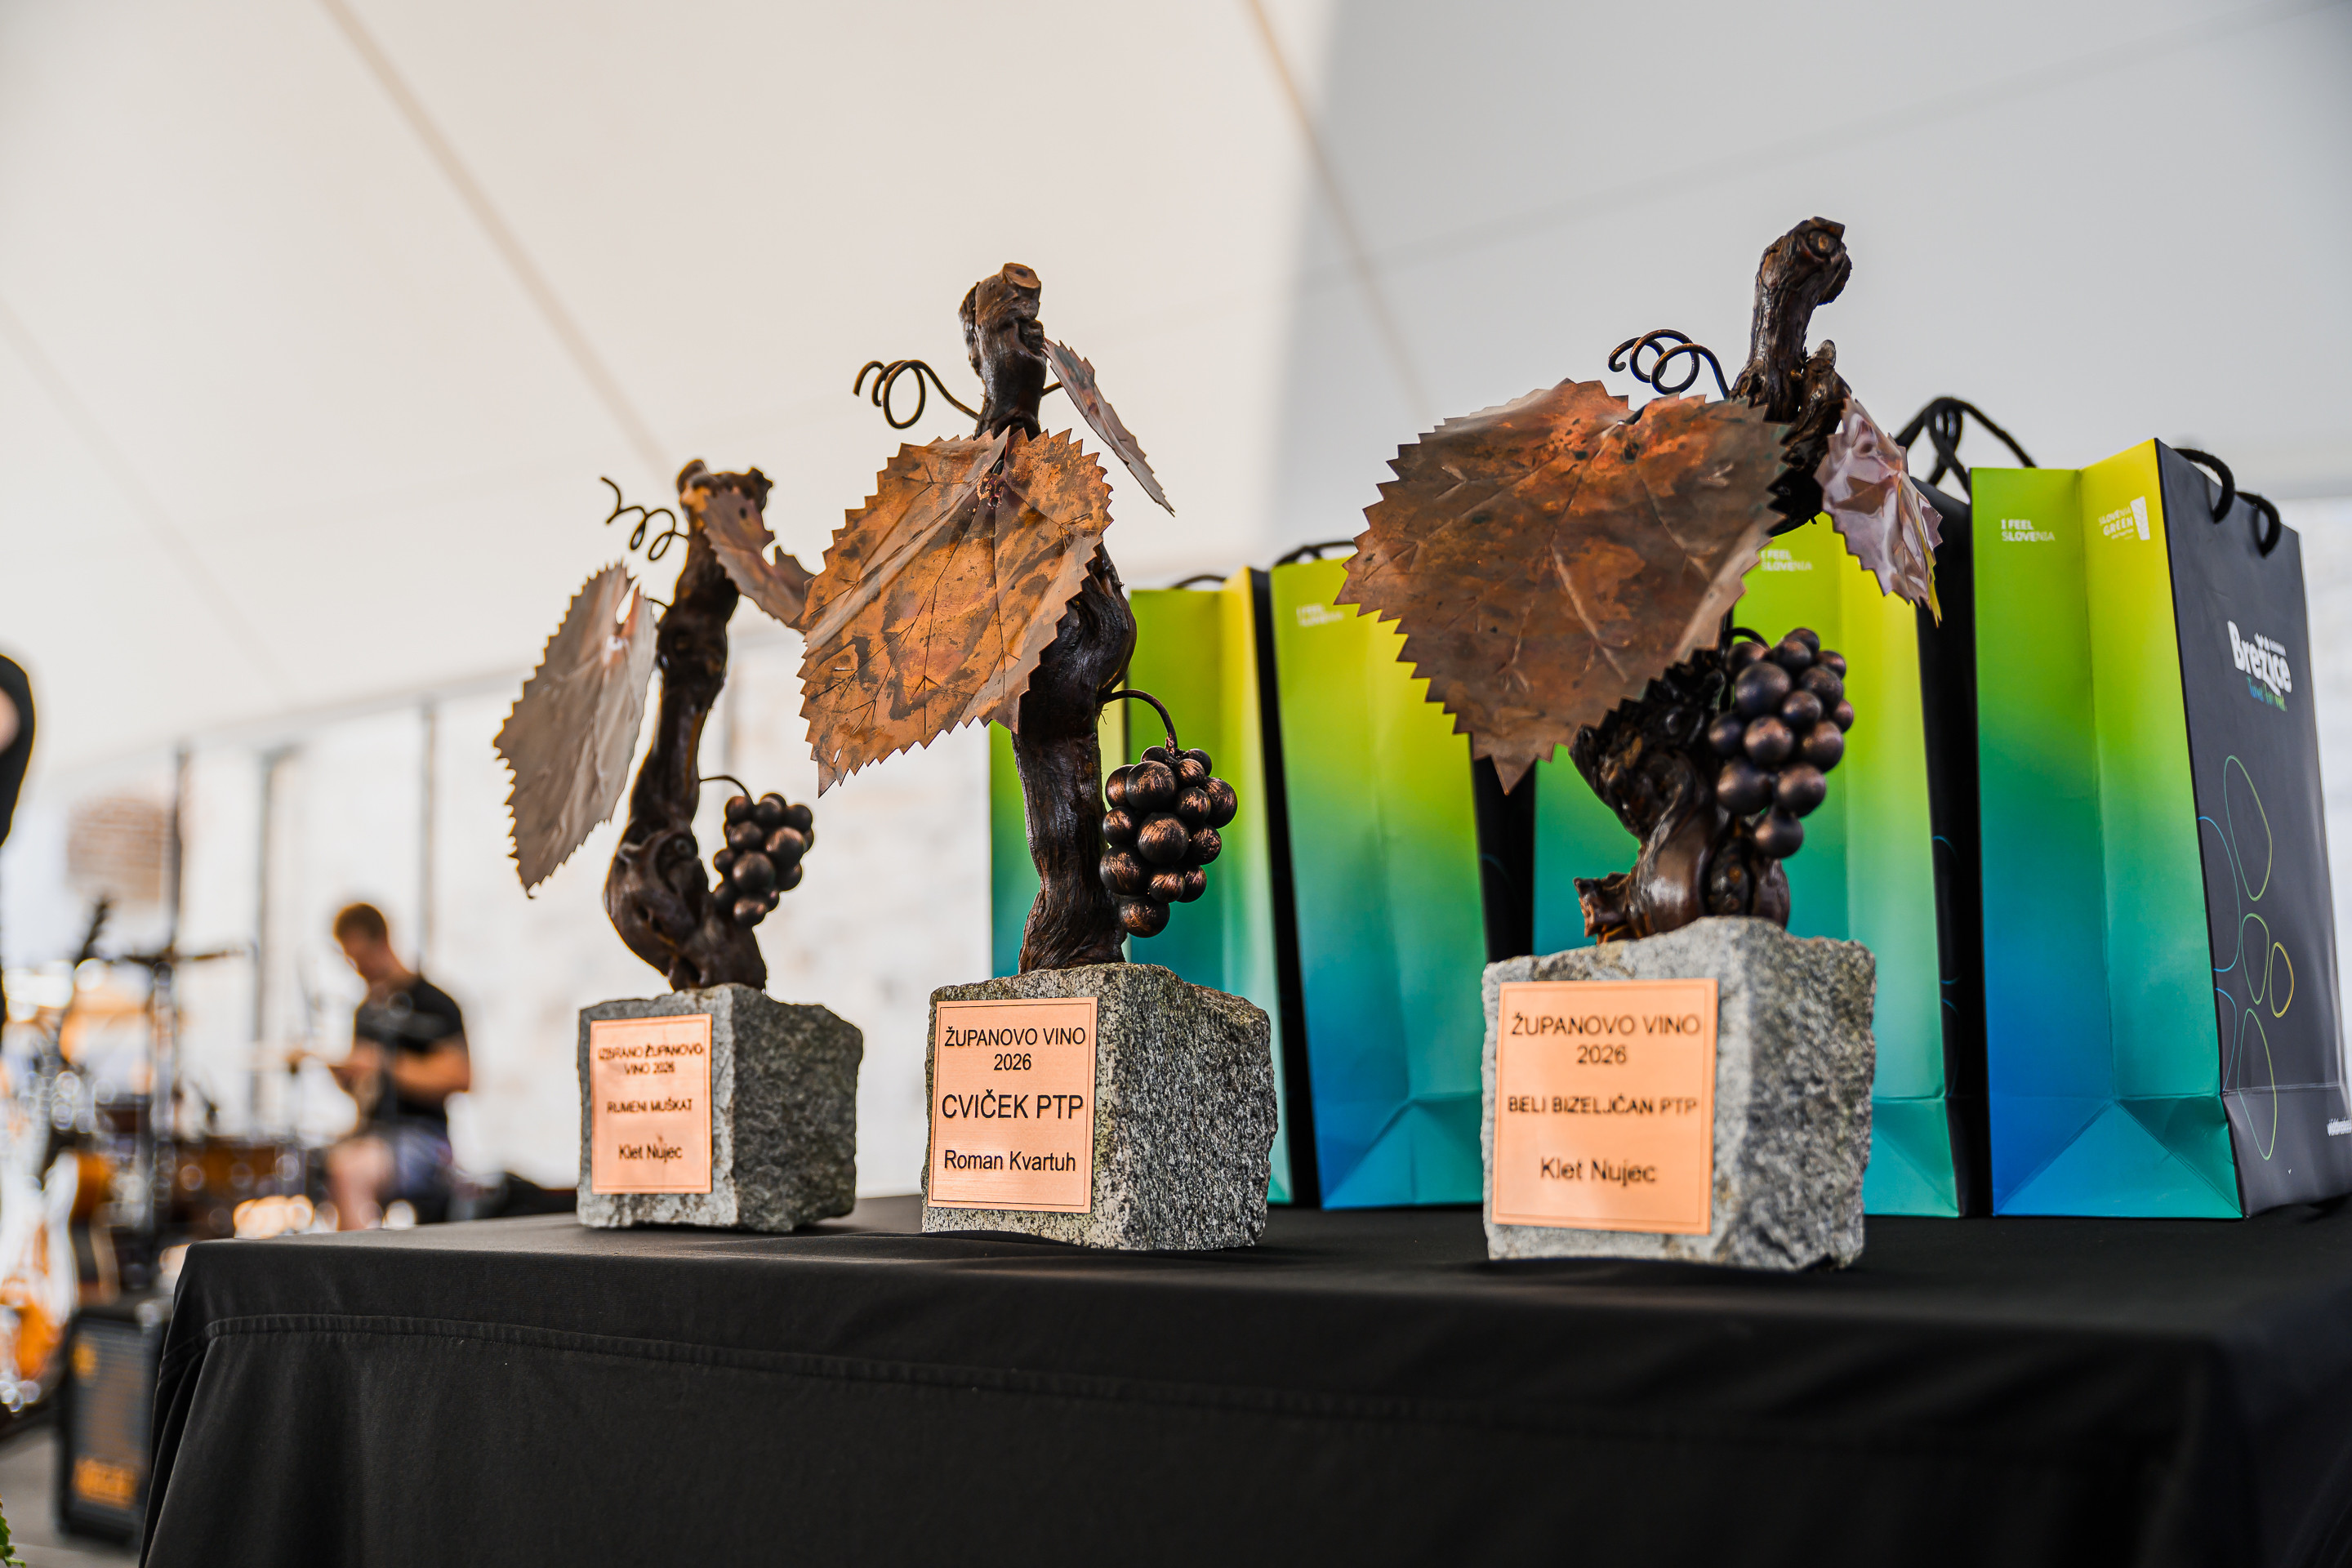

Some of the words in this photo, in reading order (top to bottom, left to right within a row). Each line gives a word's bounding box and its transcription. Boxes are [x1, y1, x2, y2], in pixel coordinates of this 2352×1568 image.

[2001, 518, 2007, 530] I
[2008, 519, 2034, 530] FEEL
[2103, 515, 2133, 537] GREEN
[2001, 531, 2056, 542] SLOVENIA
[1510, 1012, 1635, 1036] ŽUPANOVO
[1642, 1013, 1701, 1036] VINO
[944, 1026, 1038, 1047] ŽUPANOVO
[1043, 1027, 1086, 1045] VINO
[644, 1042, 704, 1058] ŽUPANOVO
[1576, 1044, 1628, 1065] 2026
[624, 1062, 651, 1075] VINO
[993, 1053, 1032, 1071] 2026
[606, 1100, 648, 1114] RUMENI
[650, 1096, 693, 1112] MUŠKAT
[942, 1089, 1029, 1119] CVIČEK
[1036, 1094, 1084, 1119] PTP
[1508, 1095, 1546, 1114] BELI
[1552, 1093, 1654, 1115] BIZELJČAN
[1659, 1097, 1698, 1115] PTP
[618, 1144, 644, 1160] Klet
[646, 1143, 684, 1163] Nujec
[944, 1149, 1004, 1170] Roman
[1009, 1151, 1076, 1171] Kvartuh
[1540, 1156, 1583, 1180] Klet
[1591, 1158, 1659, 1187] Nujec
